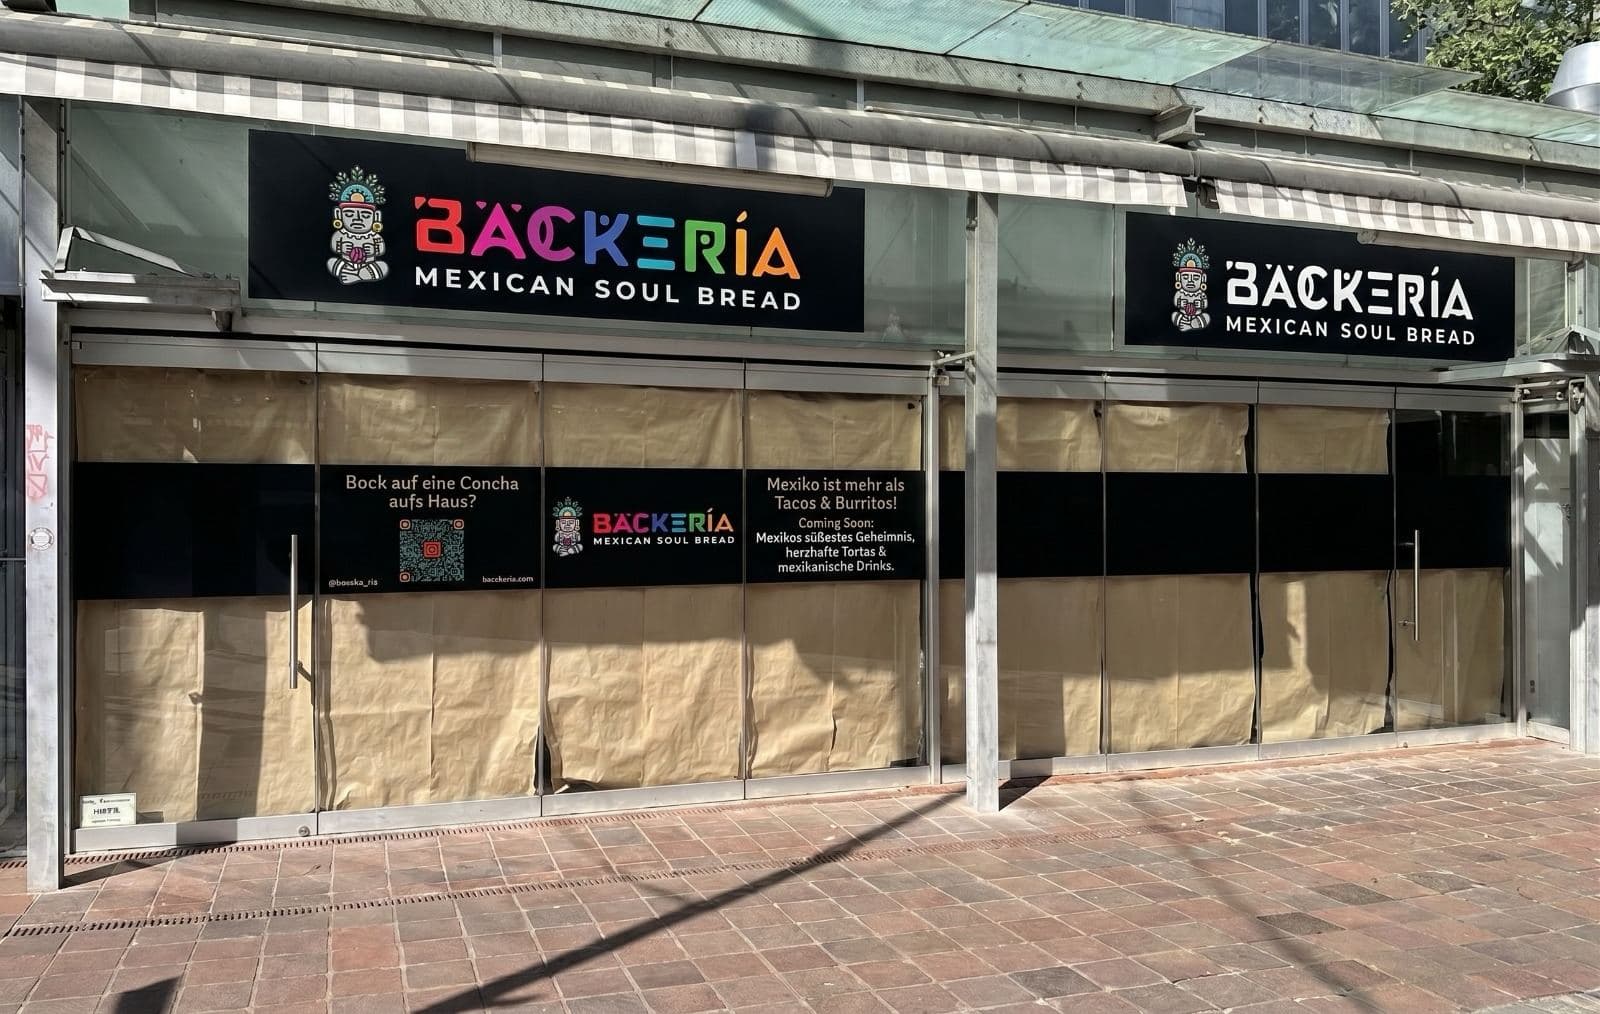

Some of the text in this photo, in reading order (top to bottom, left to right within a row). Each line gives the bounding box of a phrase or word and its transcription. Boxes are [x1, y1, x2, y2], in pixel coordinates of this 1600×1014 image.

[414, 196, 801, 280] BÄCKERÍA
[415, 266, 801, 311] MEXICAN SOUL BREAD
[1225, 260, 1474, 321] BÄCKERÍA
[1226, 315, 1475, 345] MEXICAN SOUL BREAD
[346, 474, 520, 490] Bock auf eine Concha
[767, 476, 905, 492] Mexiko ist mehr als
[389, 493, 477, 511] aufs Haus?
[774, 495, 897, 510] Tacos & Burritos!
[798, 517, 874, 531] Coming Soon:
[593, 536, 735, 546] MEXICAN SOUL BREAD
[756, 530, 915, 544] Mexikos süßestes Geheimnis,
[785, 545, 887, 559] herzhafte Tortas &
[778, 559, 895, 573] mexikanische Drinks.
